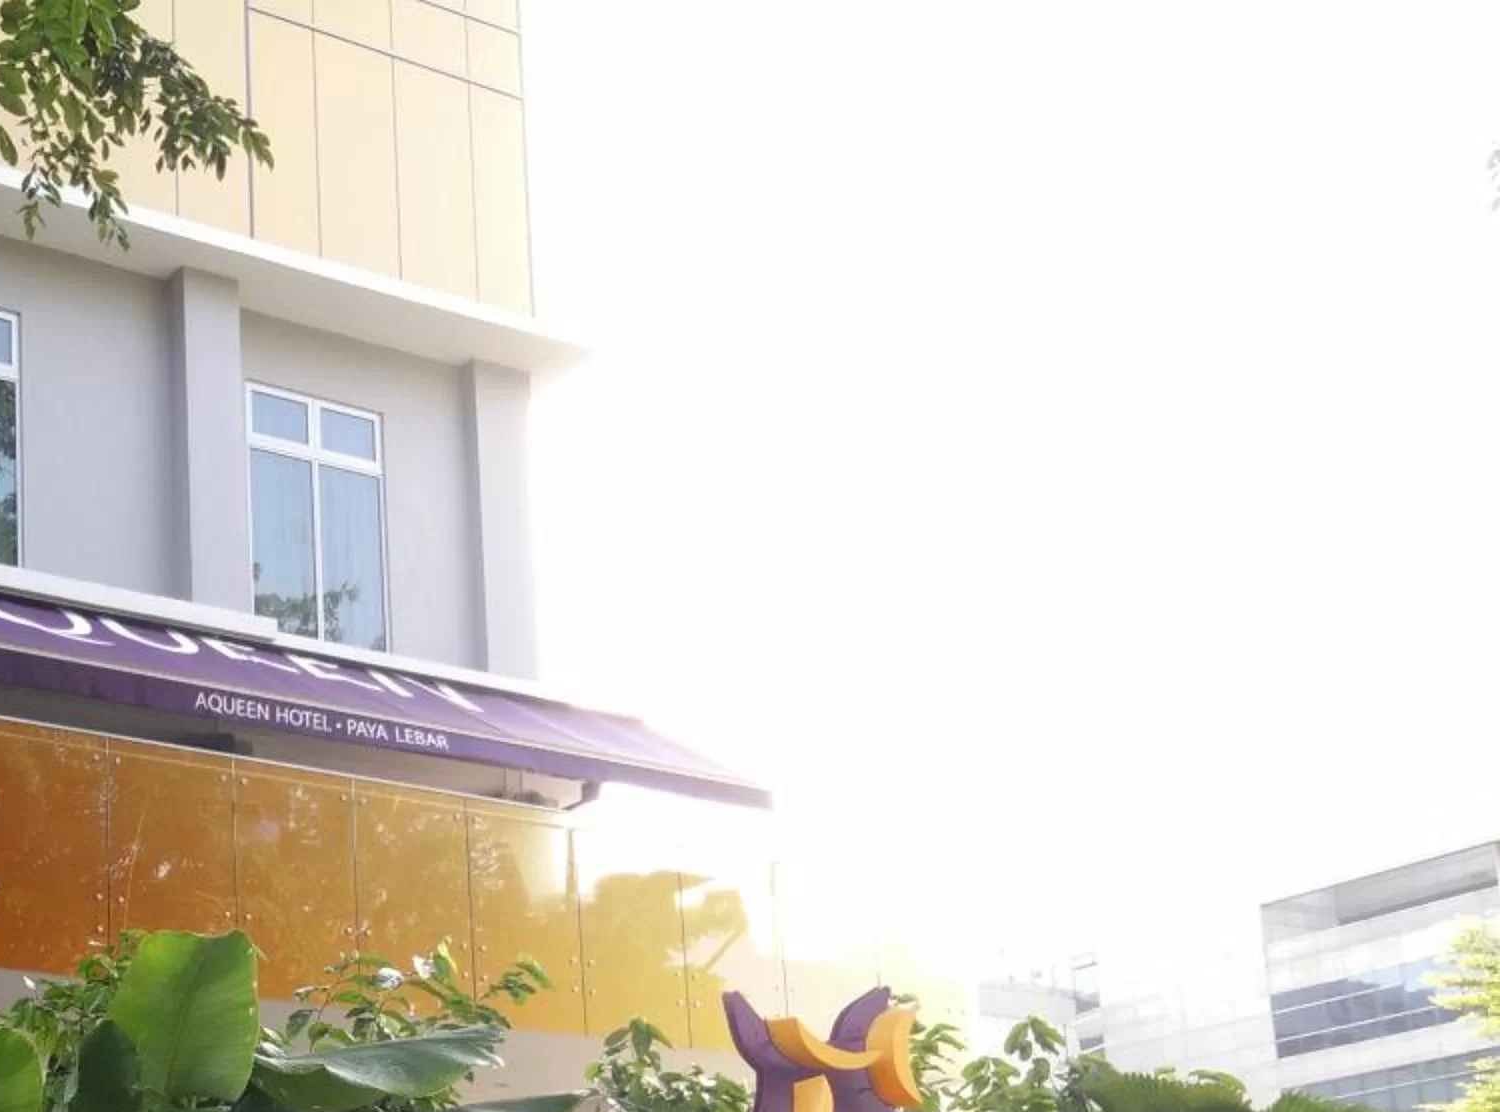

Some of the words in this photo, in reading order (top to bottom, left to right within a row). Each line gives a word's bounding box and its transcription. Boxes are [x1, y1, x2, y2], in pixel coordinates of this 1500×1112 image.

[194, 691, 270, 722] AQUEEN
[275, 705, 332, 733] HOTEL
[346, 719, 389, 742] PAYA
[395, 725, 449, 750] LEBAR
